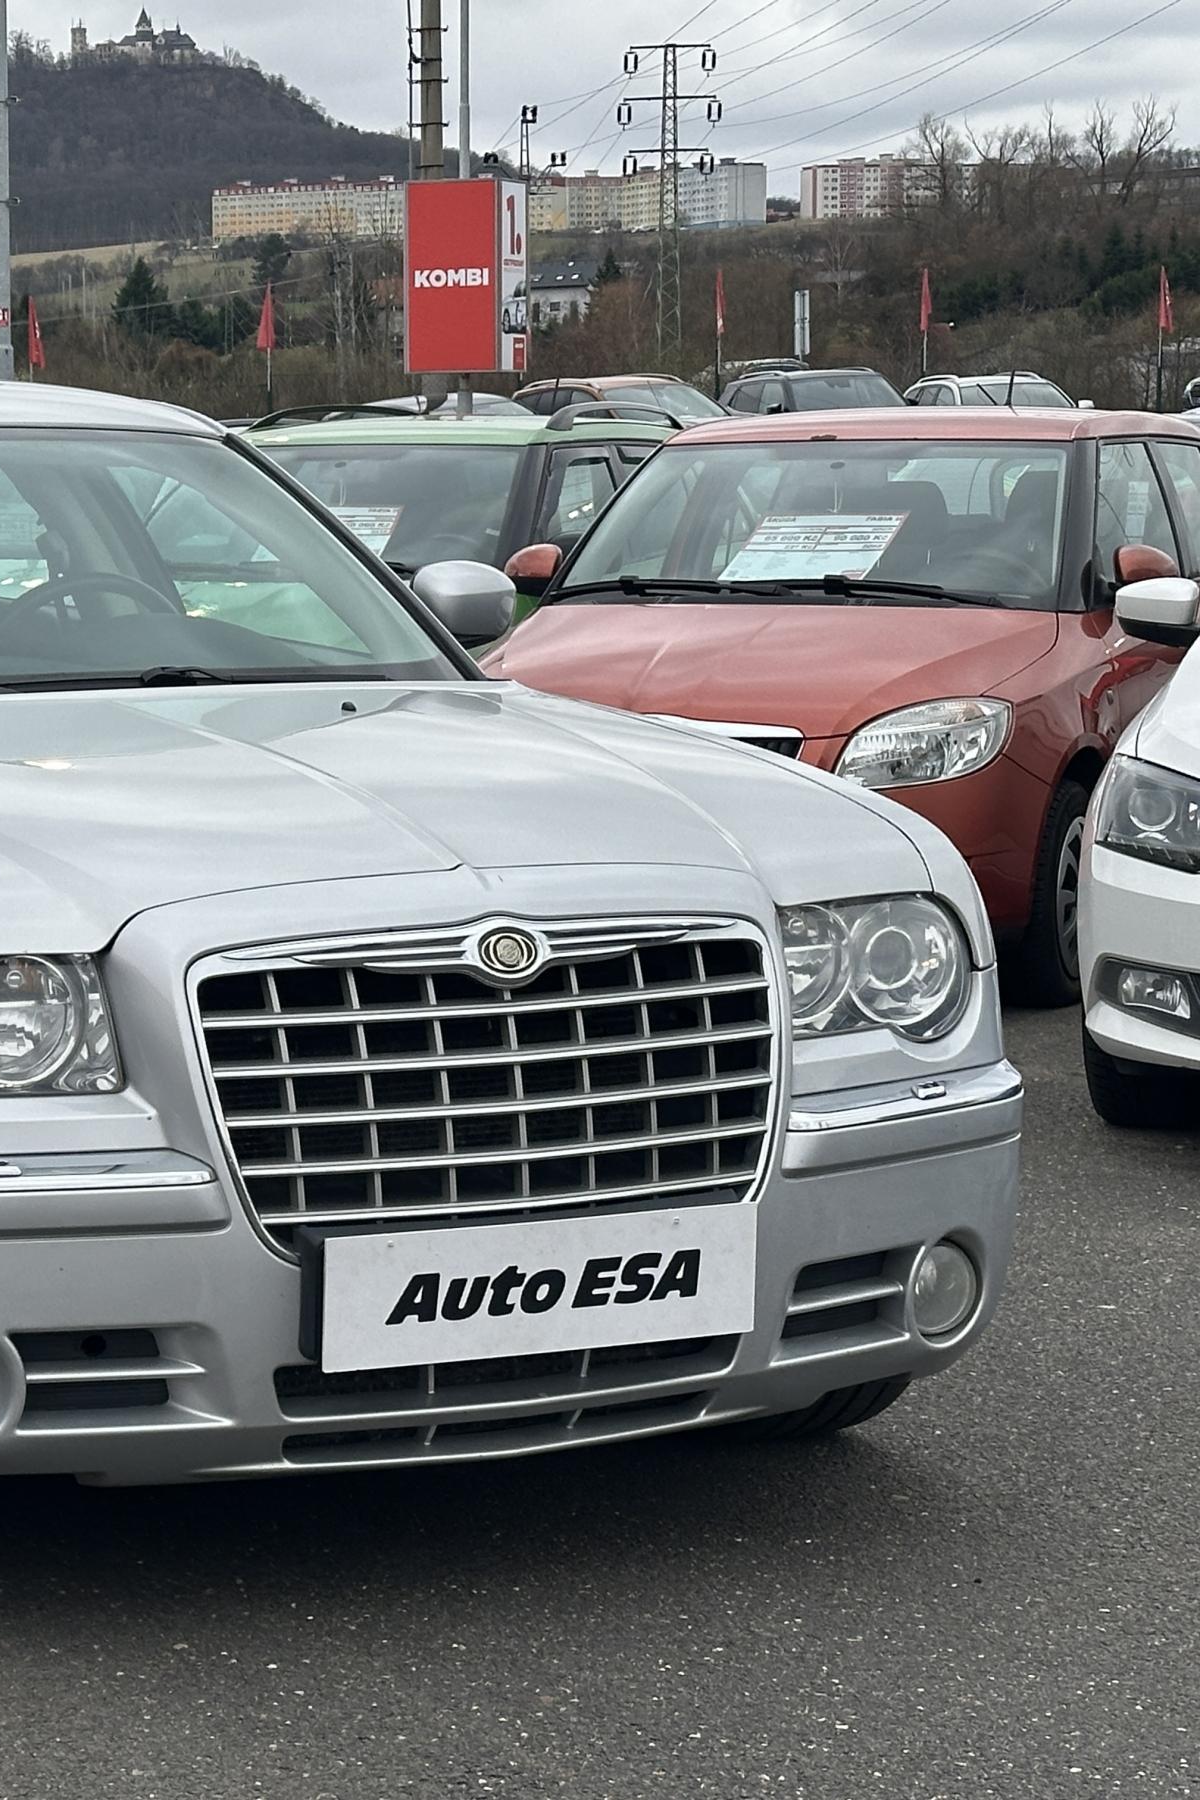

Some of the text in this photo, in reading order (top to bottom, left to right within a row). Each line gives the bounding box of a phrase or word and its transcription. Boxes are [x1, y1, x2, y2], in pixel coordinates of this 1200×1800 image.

[414, 267, 489, 288] KOMBI
[384, 1248, 701, 1326] Auto ESA
